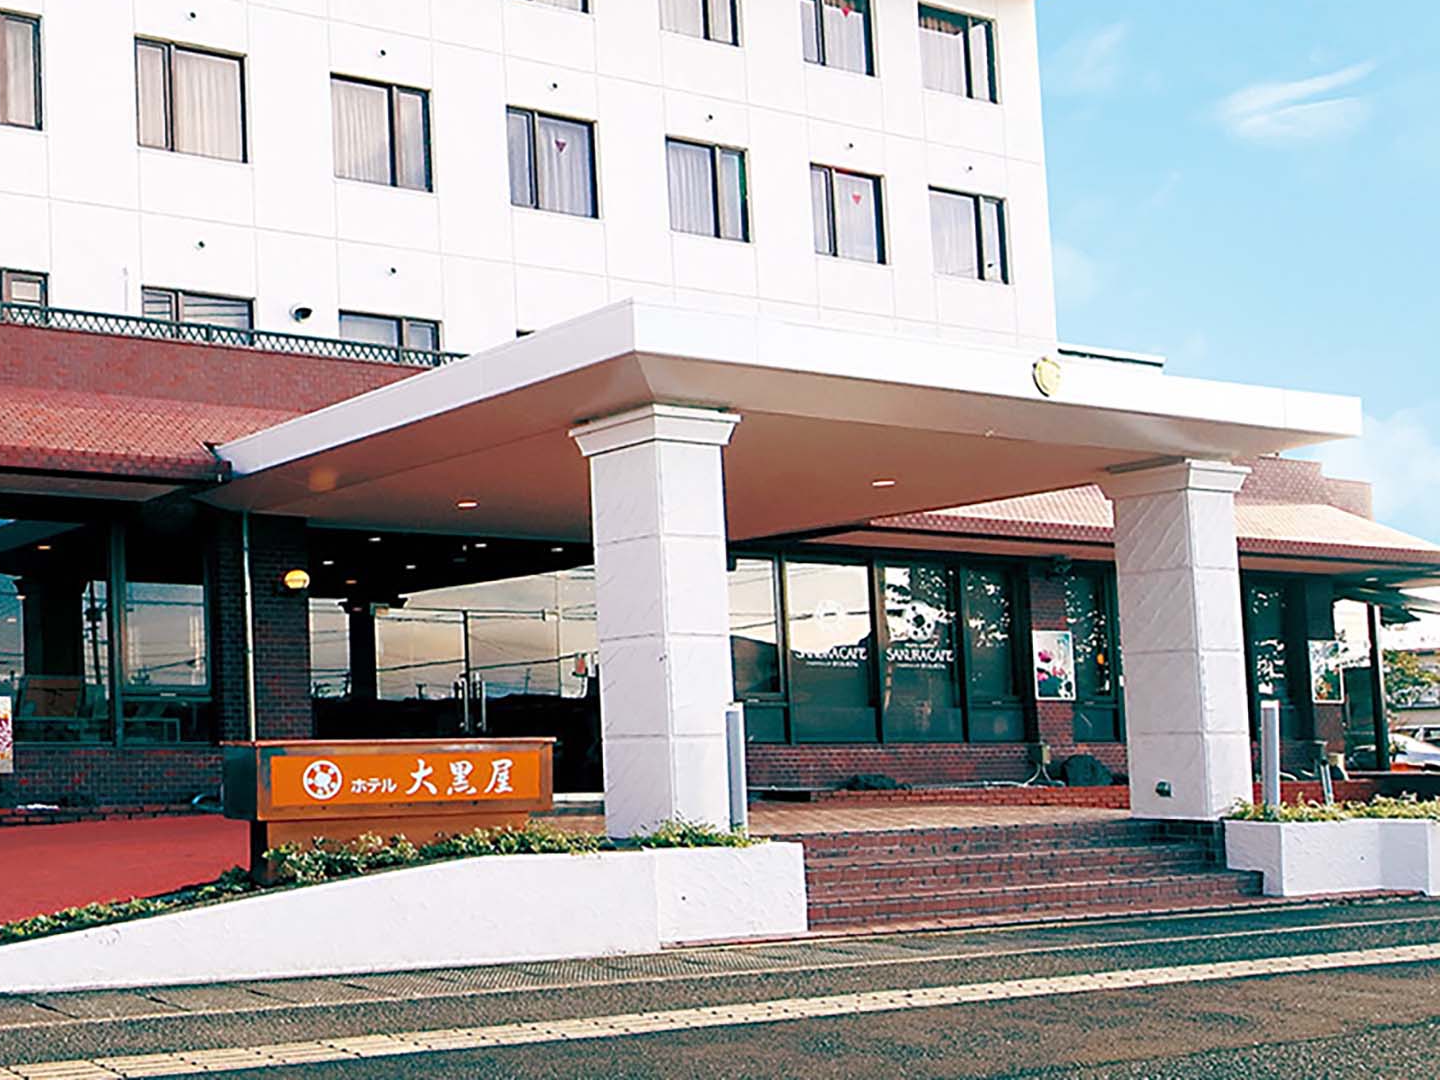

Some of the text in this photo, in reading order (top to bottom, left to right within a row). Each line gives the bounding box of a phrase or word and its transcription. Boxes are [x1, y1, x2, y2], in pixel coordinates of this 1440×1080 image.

[351, 759, 514, 796] ホテル 大黒屋
